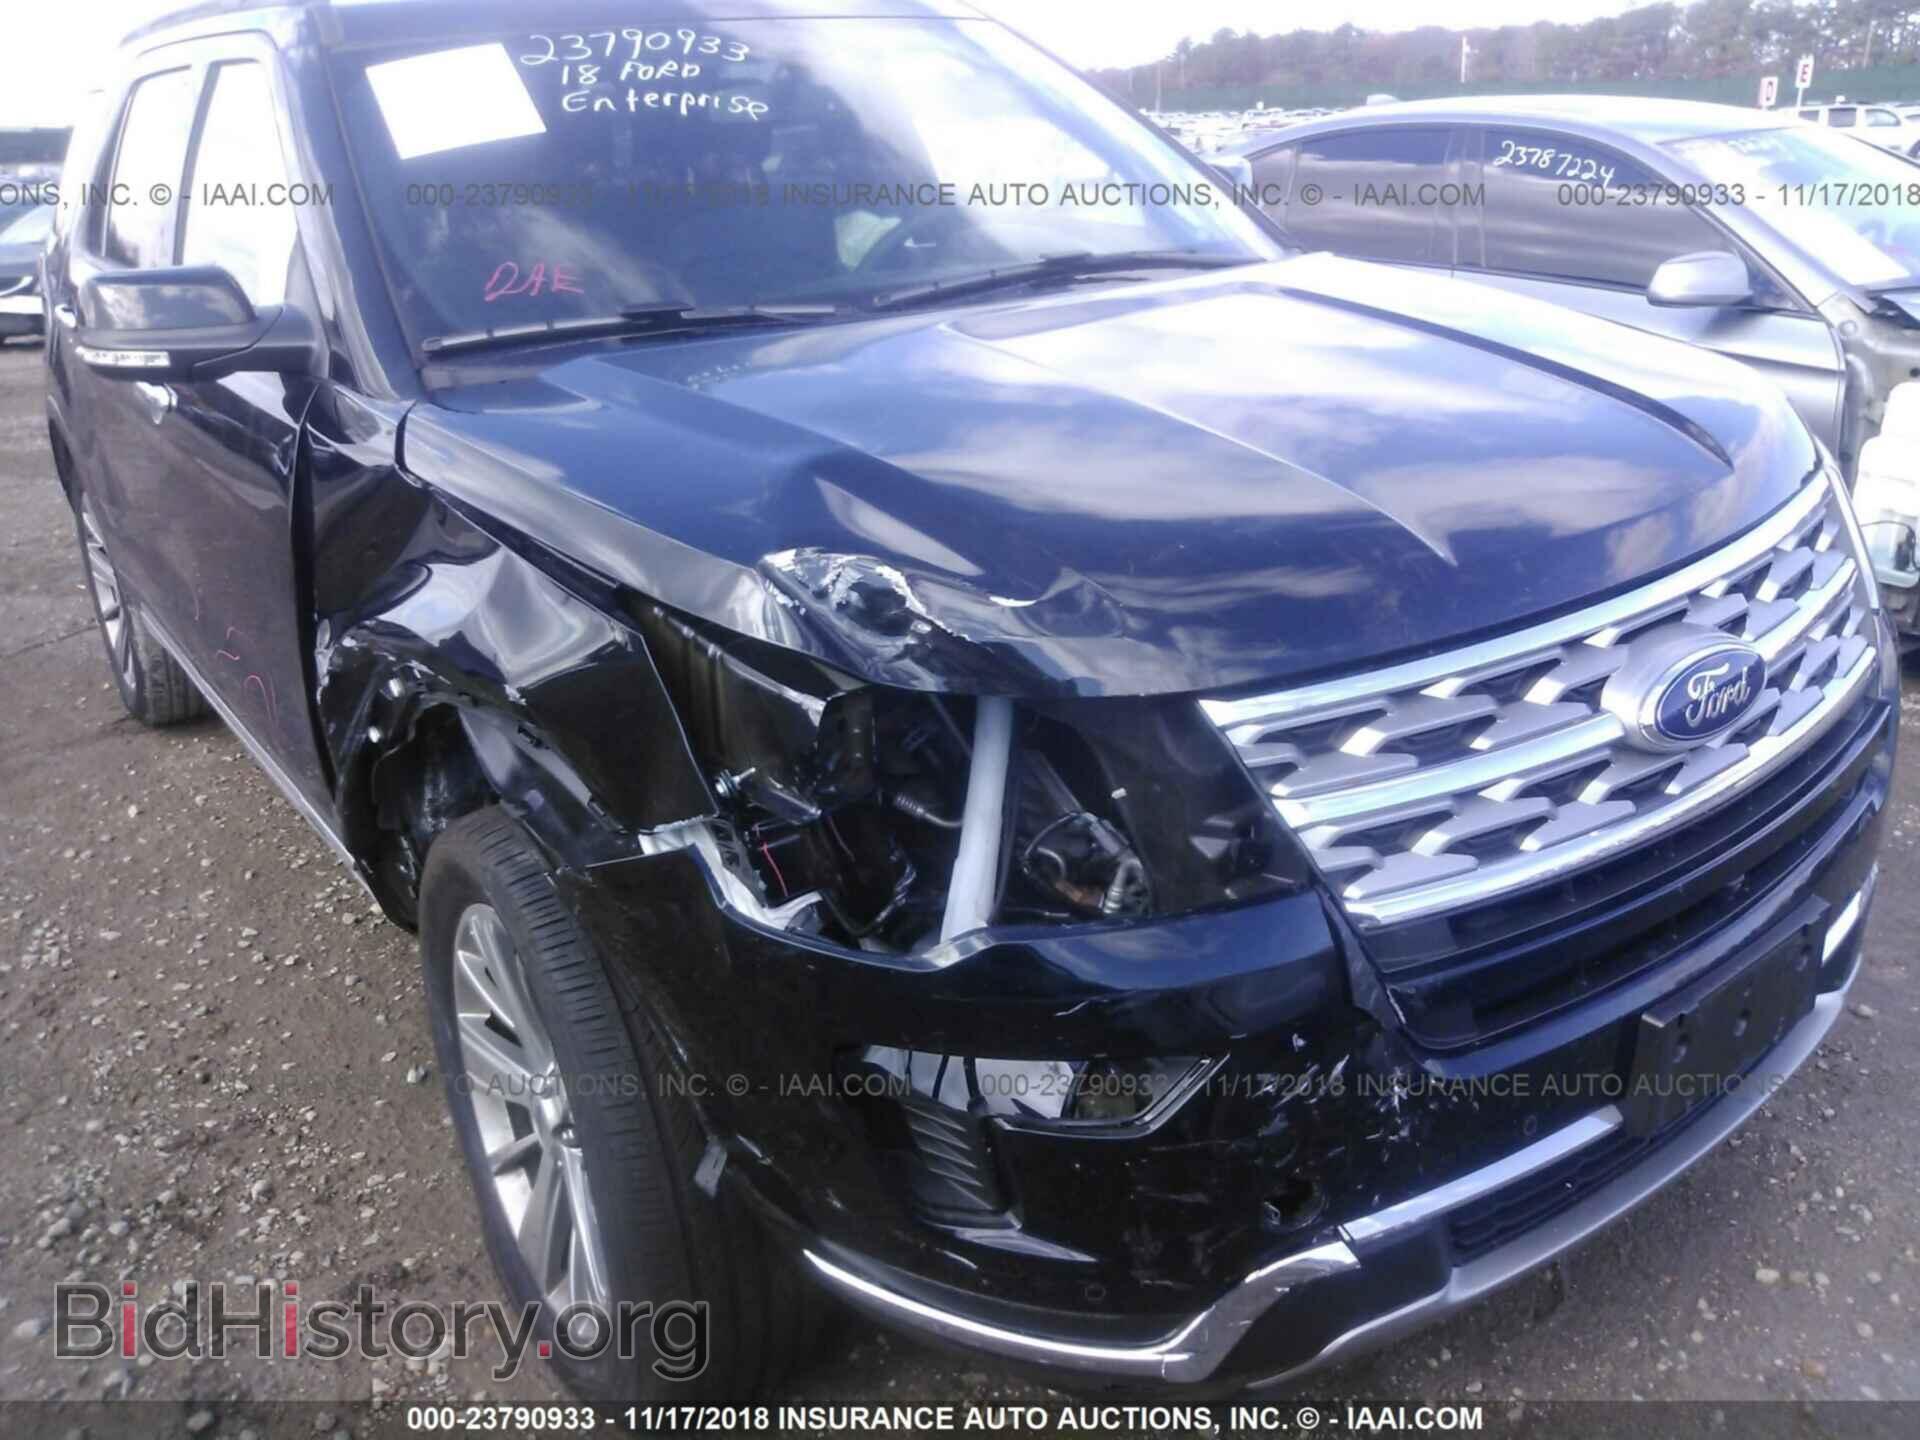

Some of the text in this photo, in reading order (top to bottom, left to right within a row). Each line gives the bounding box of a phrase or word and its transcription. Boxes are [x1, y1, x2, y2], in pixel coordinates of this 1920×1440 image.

[519, 28, 751, 66] 23790933
[561, 60, 702, 86] 18 FORD
[561, 88, 770, 122] Enterprise
[1492, 139, 1616, 189] 23787224
[1685, 662, 1751, 728] Ford
